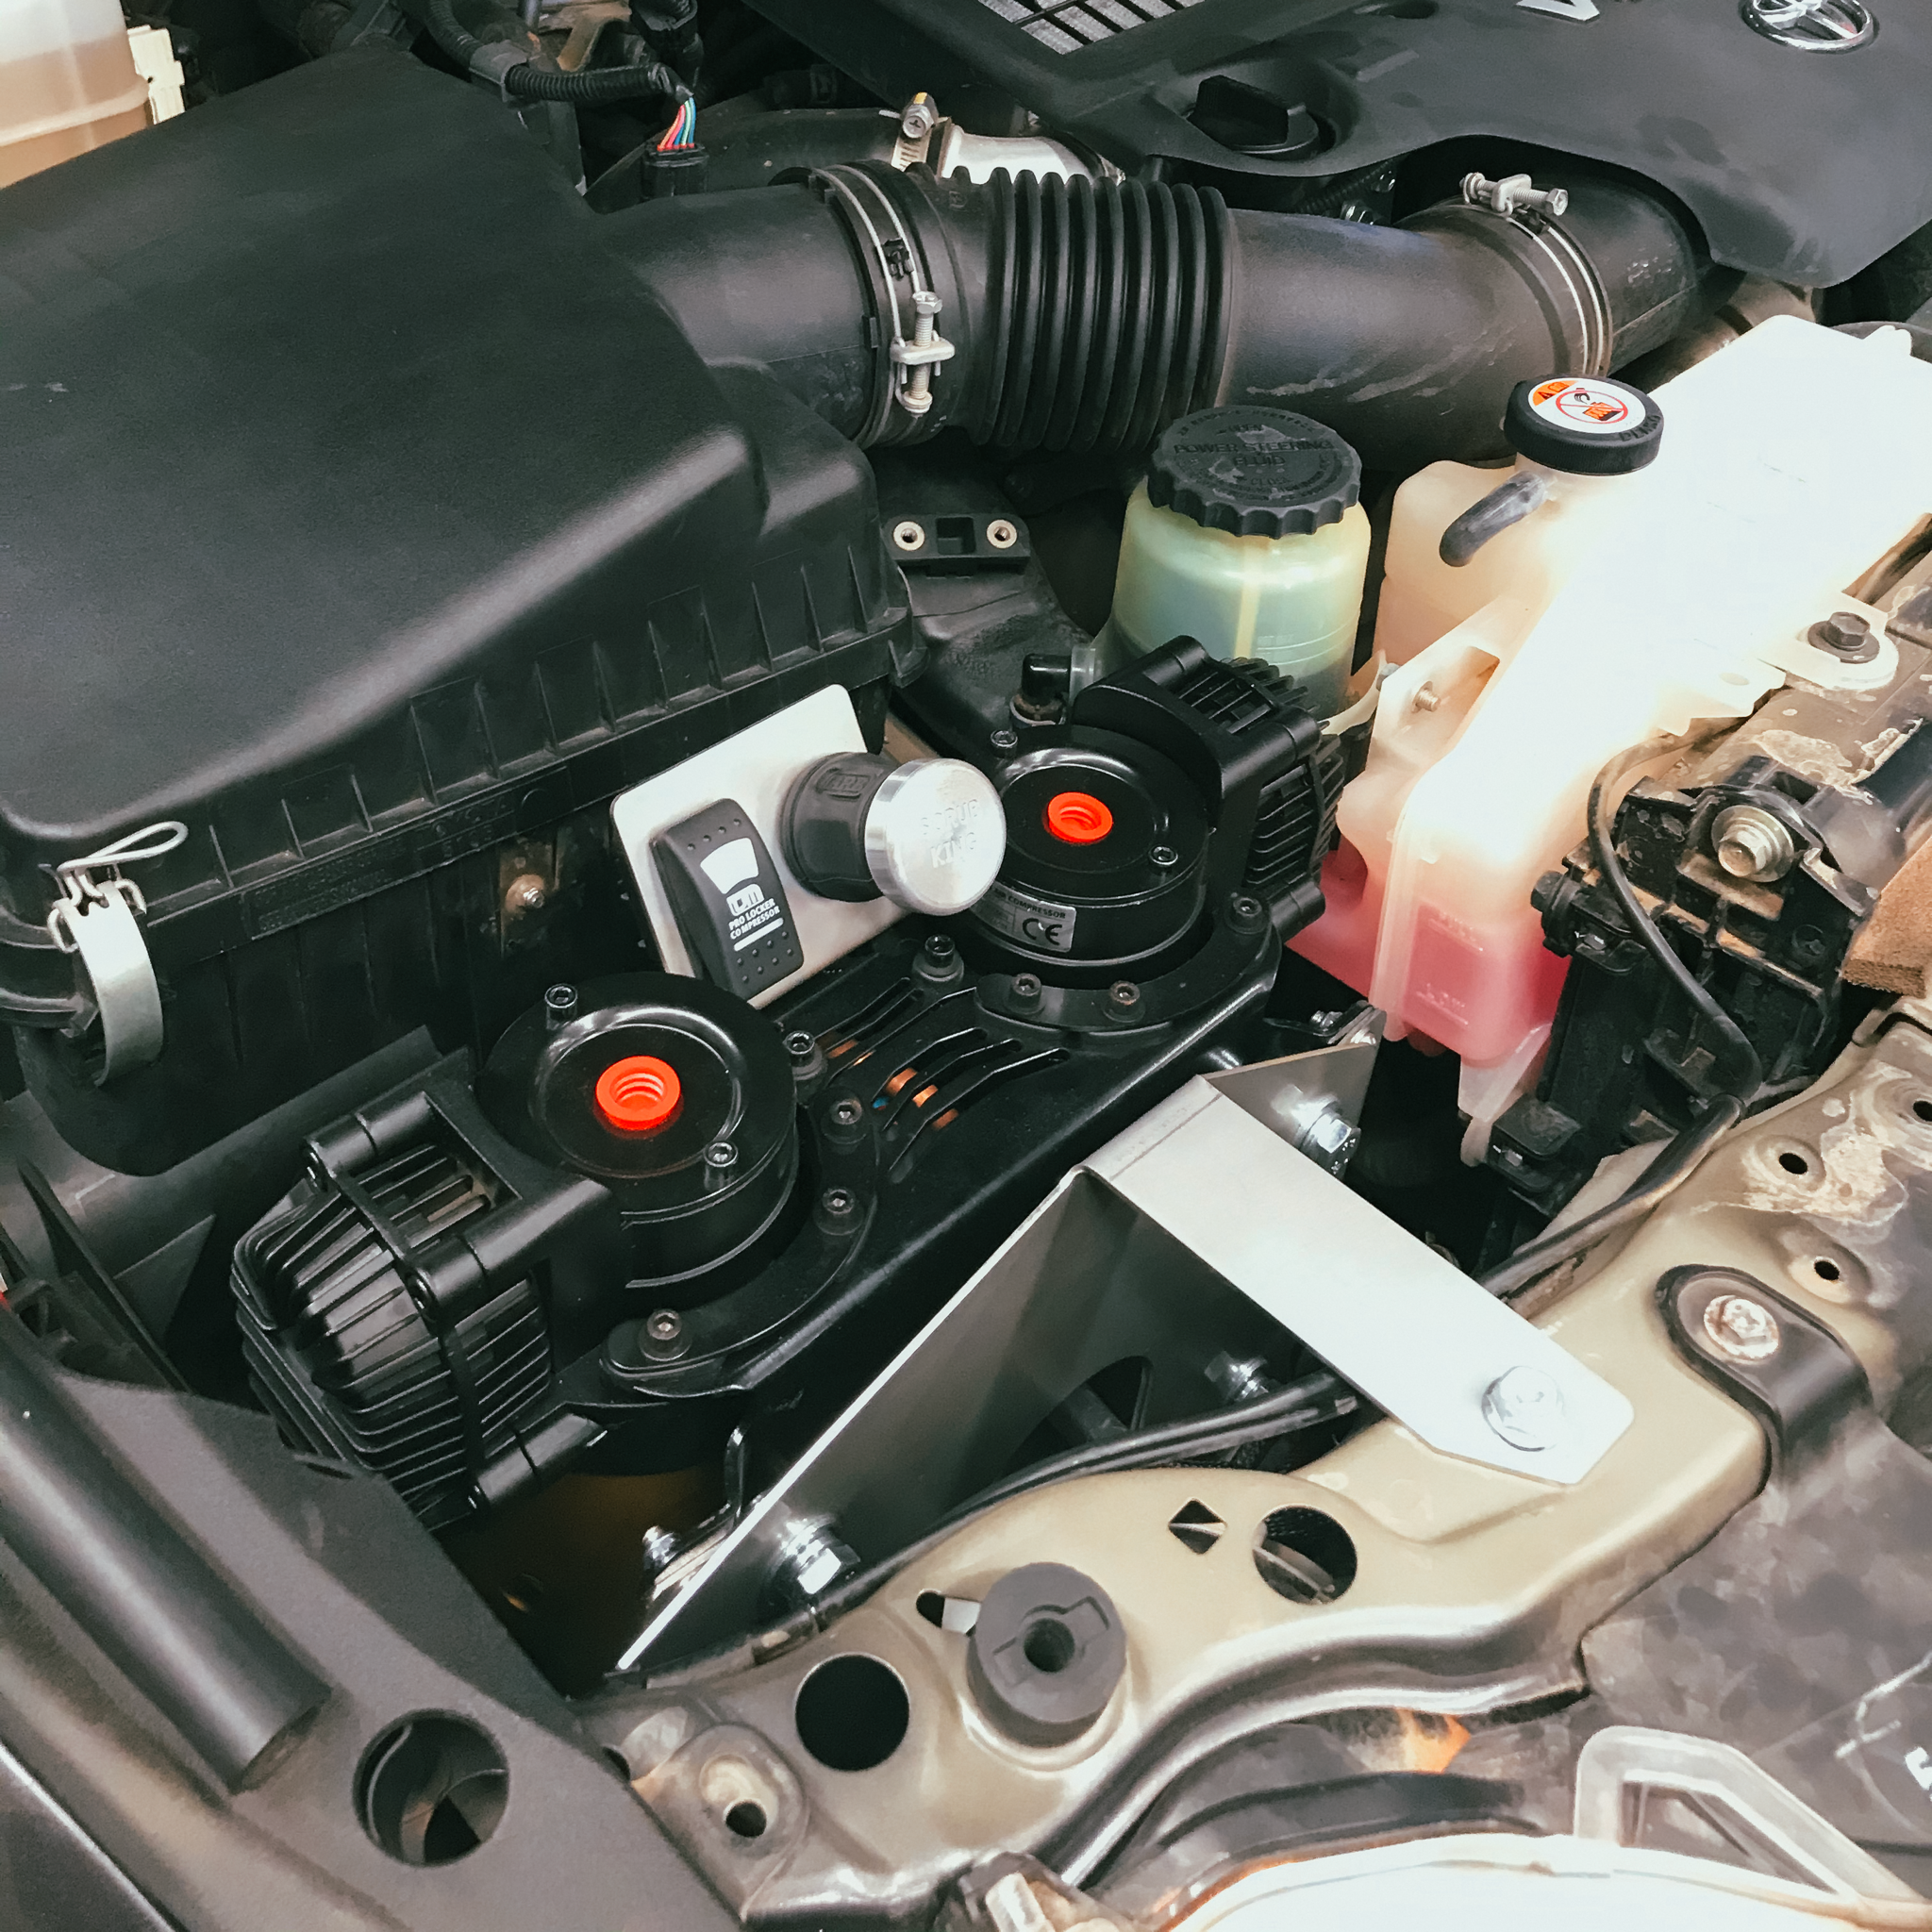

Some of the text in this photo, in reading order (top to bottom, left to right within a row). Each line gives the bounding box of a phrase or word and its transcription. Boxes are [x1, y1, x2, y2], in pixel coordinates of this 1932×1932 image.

[1173, 440, 1336, 455] POWER STEERING
[1233, 456, 1286, 467] FLUID
[929, 831, 978, 869] KING
[727, 898, 776, 932] PRO LOCKER
[1008, 896, 1067, 920] COMPRESSOR
[729, 906, 781, 941] COMPRESSOR
[1022, 917, 1064, 946] CE
